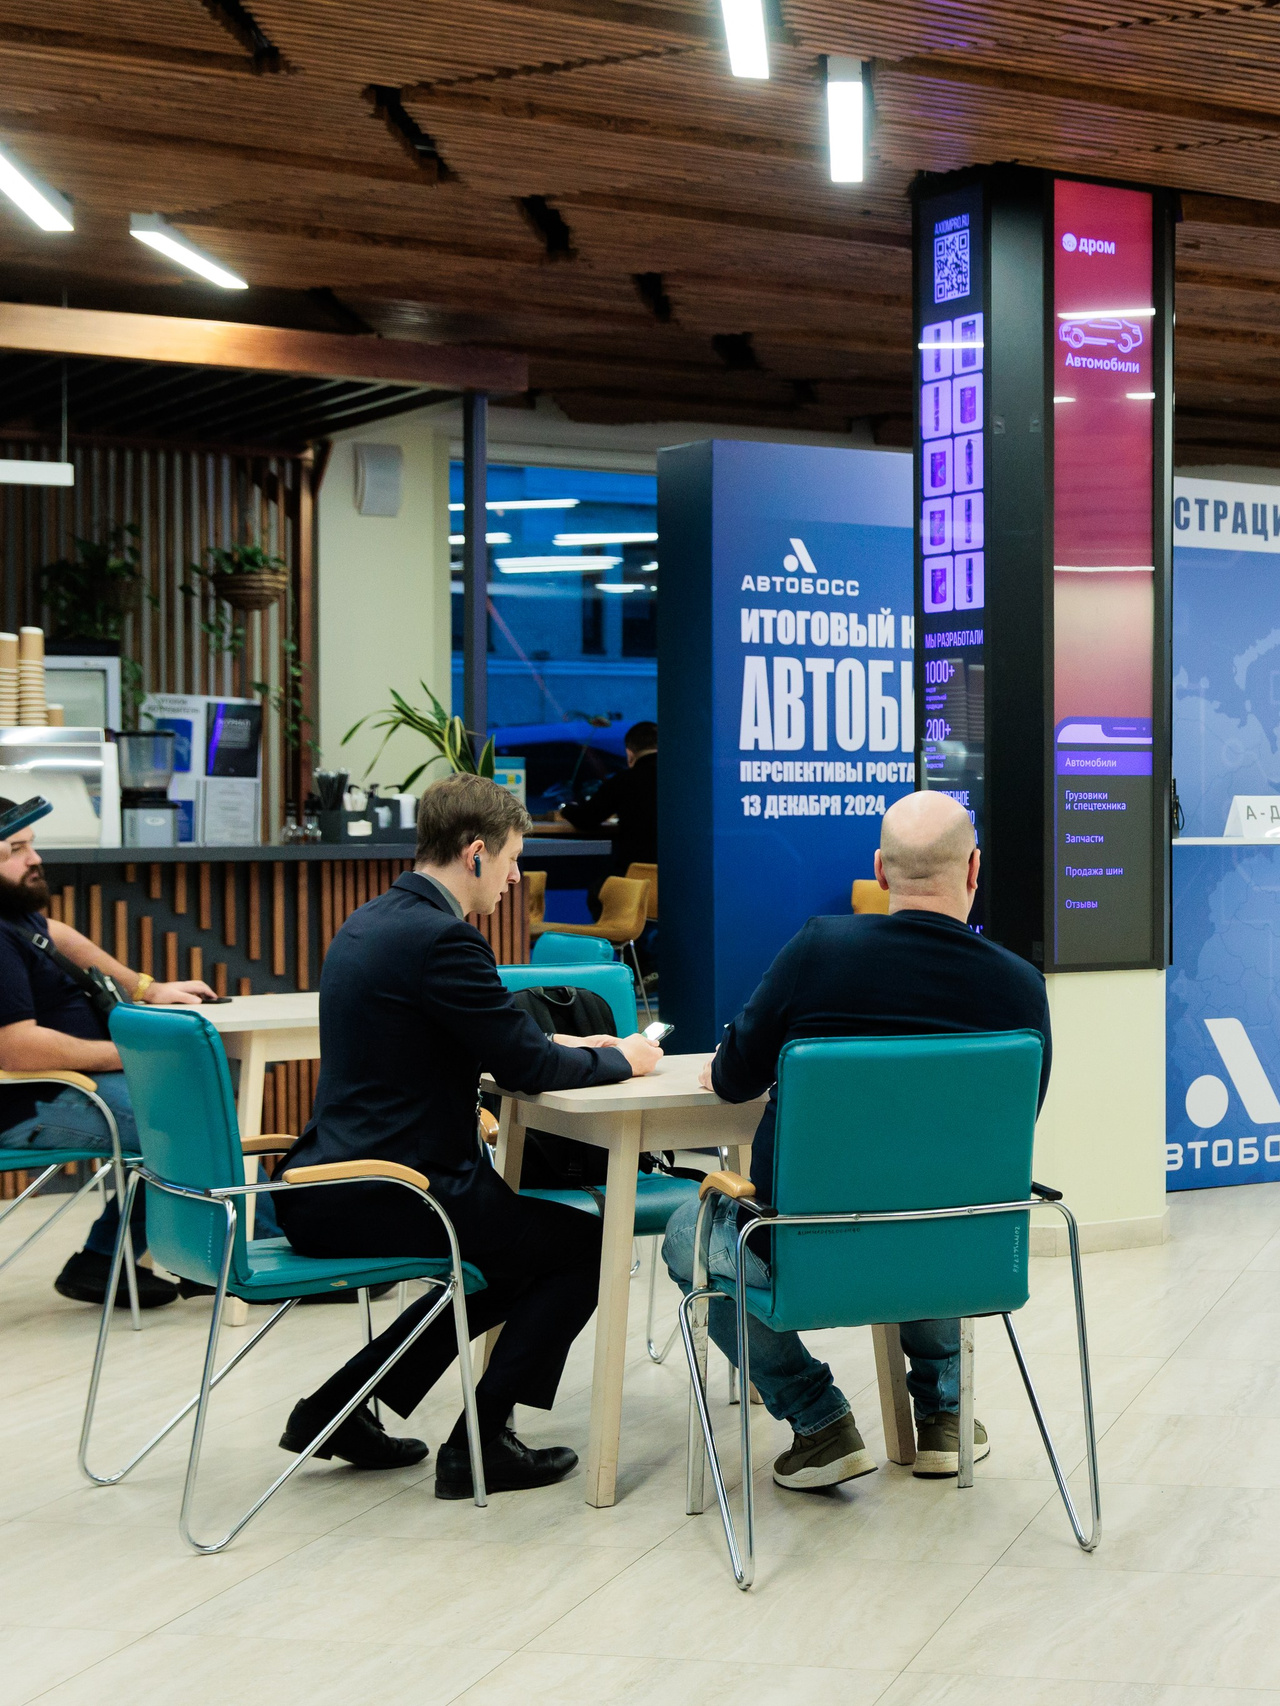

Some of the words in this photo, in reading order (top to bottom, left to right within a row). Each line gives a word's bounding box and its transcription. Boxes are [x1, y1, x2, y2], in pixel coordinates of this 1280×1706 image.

[1079, 237, 1116, 255] дром
[1065, 352, 1140, 373] Автомобили
[741, 575, 860, 597] АВТОБОСС
[740, 607, 895, 648] ИТОГОВЫЙ
[925, 633, 937, 649] МЫ
[937, 629, 984, 647] РАЗРАБОТАЛИ
[925, 660, 955, 684] 1000+
[925, 718, 951, 742] 200+
[739, 761, 863, 783] ПЕРСПЕКТИВЫ
[1065, 757, 1117, 767] Автомобили
[1065, 790, 1108, 802] Грузовики
[741, 795, 761, 816] 13
[764, 795, 841, 819] ДЕКАБРЯ
[844, 795, 886, 816] 2024
[1073, 802, 1127, 812] спецтехника
[1065, 833, 1104, 844] Запчасти
[1065, 866, 1103, 877] Продажа
[1105, 866, 1124, 875] шин
[1065, 899, 1098, 909] Отзывы
